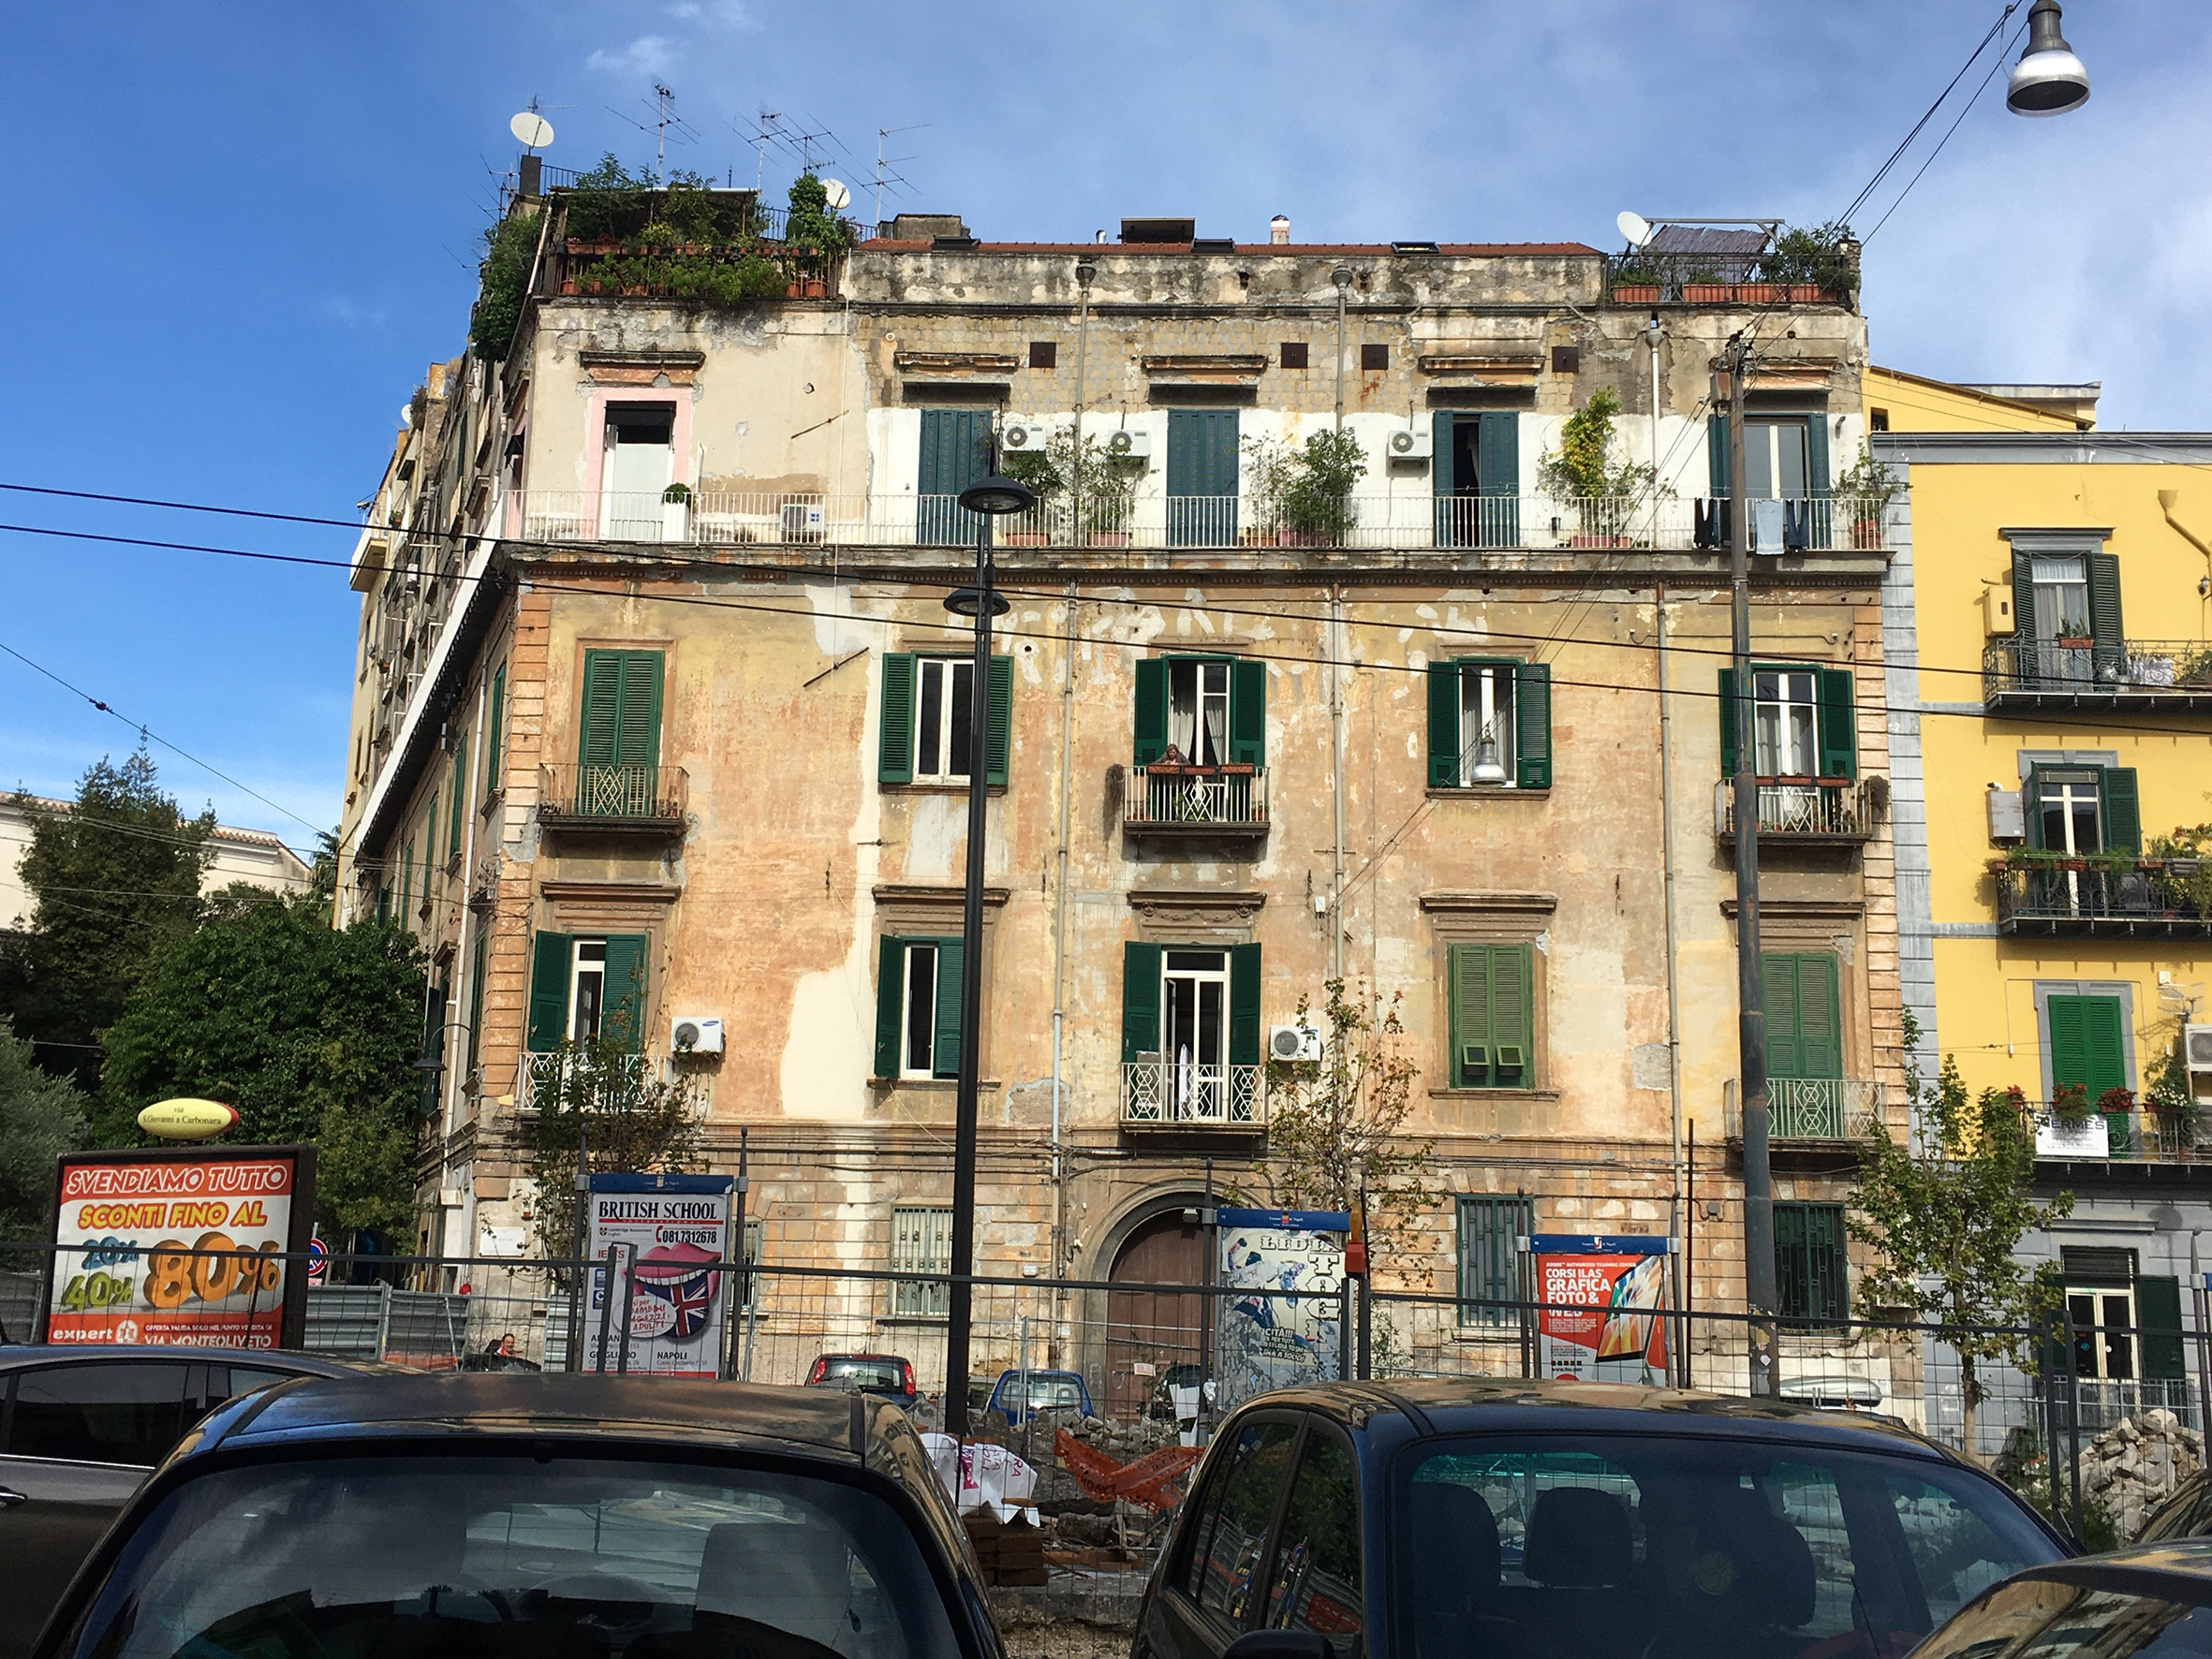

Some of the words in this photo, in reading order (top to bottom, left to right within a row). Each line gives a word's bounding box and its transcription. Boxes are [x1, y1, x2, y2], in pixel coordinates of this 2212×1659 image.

[142, 1114, 174, 1123] S.Giovanni
[181, 1115, 222, 1124] Carbonara
[2044, 1120, 2105, 1130] ERMES
[66, 1167, 205, 1195] SVENDIAMO
[208, 1165, 288, 1191] TUTTO
[77, 1203, 168, 1229] SCONTI
[168, 1201, 230, 1228] FINO
[229, 1201, 269, 1227] AL
[599, 1201, 659, 1222] BRITISH
[663, 1202, 717, 1219] SCHOOL
[662, 1230, 717, 1243] 081.7312678
[81, 1236, 140, 1270] 20%
[597, 1249, 626, 1259] IES
[142, 1231, 281, 1310] 80%
[1545, 1269, 1576, 1279] CORSI
[60, 1271, 134, 1312] 40%
[1546, 1279, 1612, 1291] GRAFICA
[1547, 1291, 1586, 1304] FOTO
[1587, 1291, 1600, 1304] &
[630, 1313, 666, 1322] AGAZZI
[633, 1321, 665, 1330] ADULTI
[52, 1328, 113, 1343] expert
[144, 1335, 166, 1345] VIA
[170, 1334, 273, 1348] MONTEOLIVETO
[656, 1351, 687, 1360] NAPOLI
